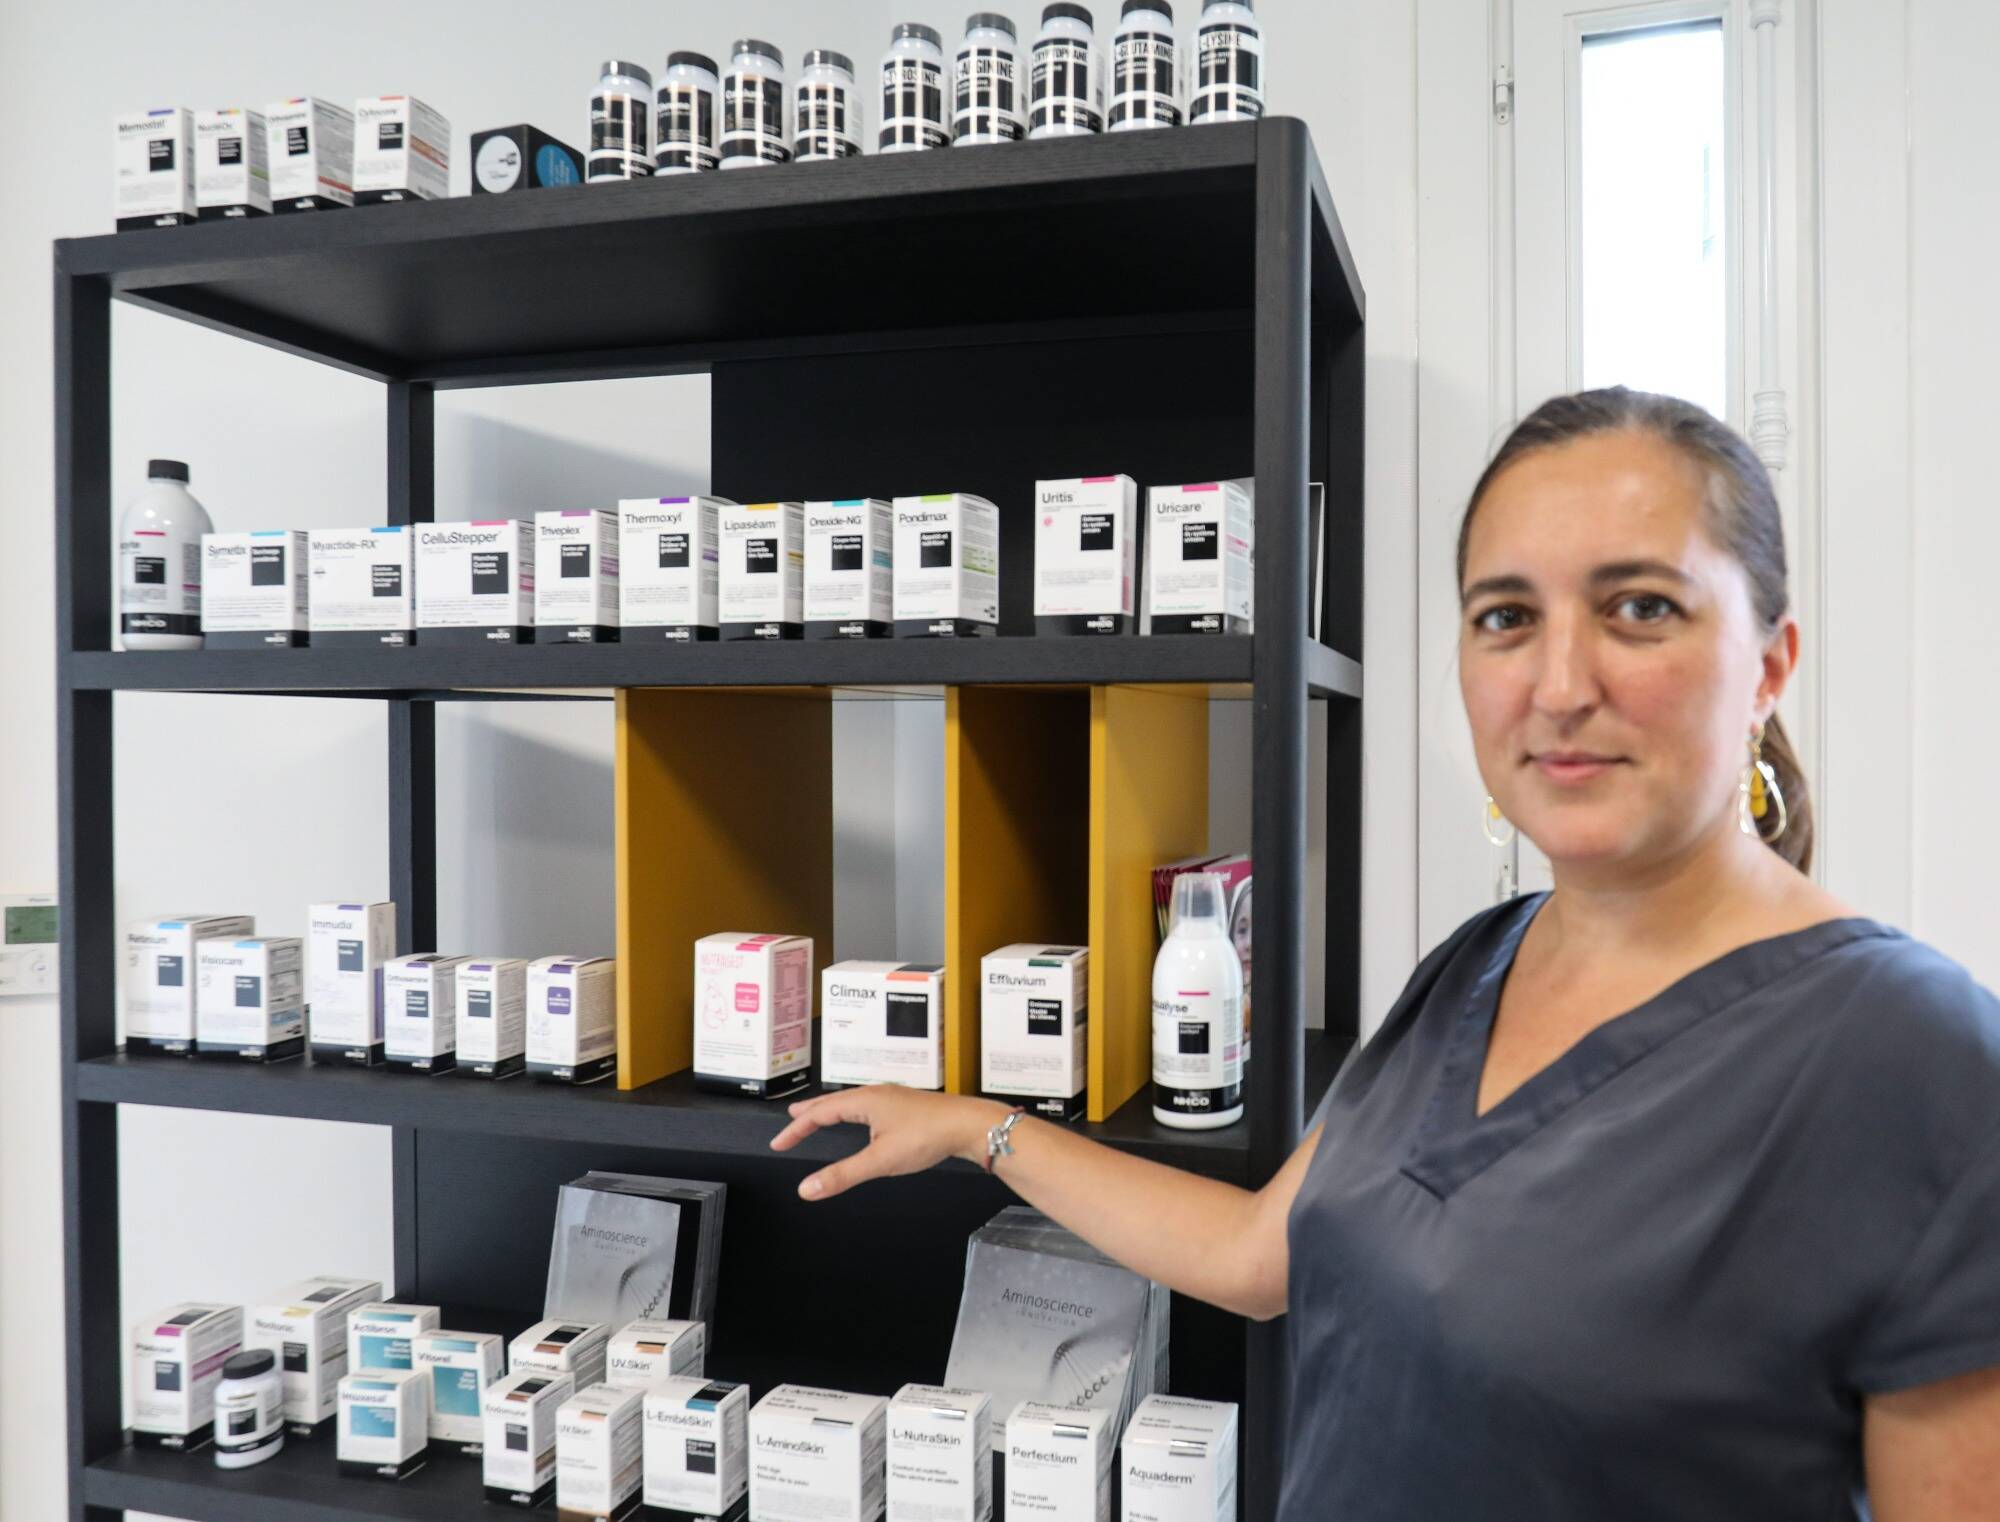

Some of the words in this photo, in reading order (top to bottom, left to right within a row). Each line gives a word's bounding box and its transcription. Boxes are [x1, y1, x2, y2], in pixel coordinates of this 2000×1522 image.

[1042, 493, 1074, 504] Uritis
[1157, 502, 1202, 514] Uricare
[625, 512, 682, 524] Thermoxyl
[421, 530, 499, 546] CelluStepper
[989, 973, 1047, 987] Effluvium
[829, 984, 877, 999] Climax
[1173, 1096, 1210, 1107] NHCO
[580, 1225, 648, 1248] Aminoscience
[1002, 1288, 1094, 1319] Aminoscience
[892, 1429, 961, 1446] L-NutraSkin
[1012, 1446, 1077, 1465] Perfectium
[1129, 1466, 1193, 1485] Aquaderm
